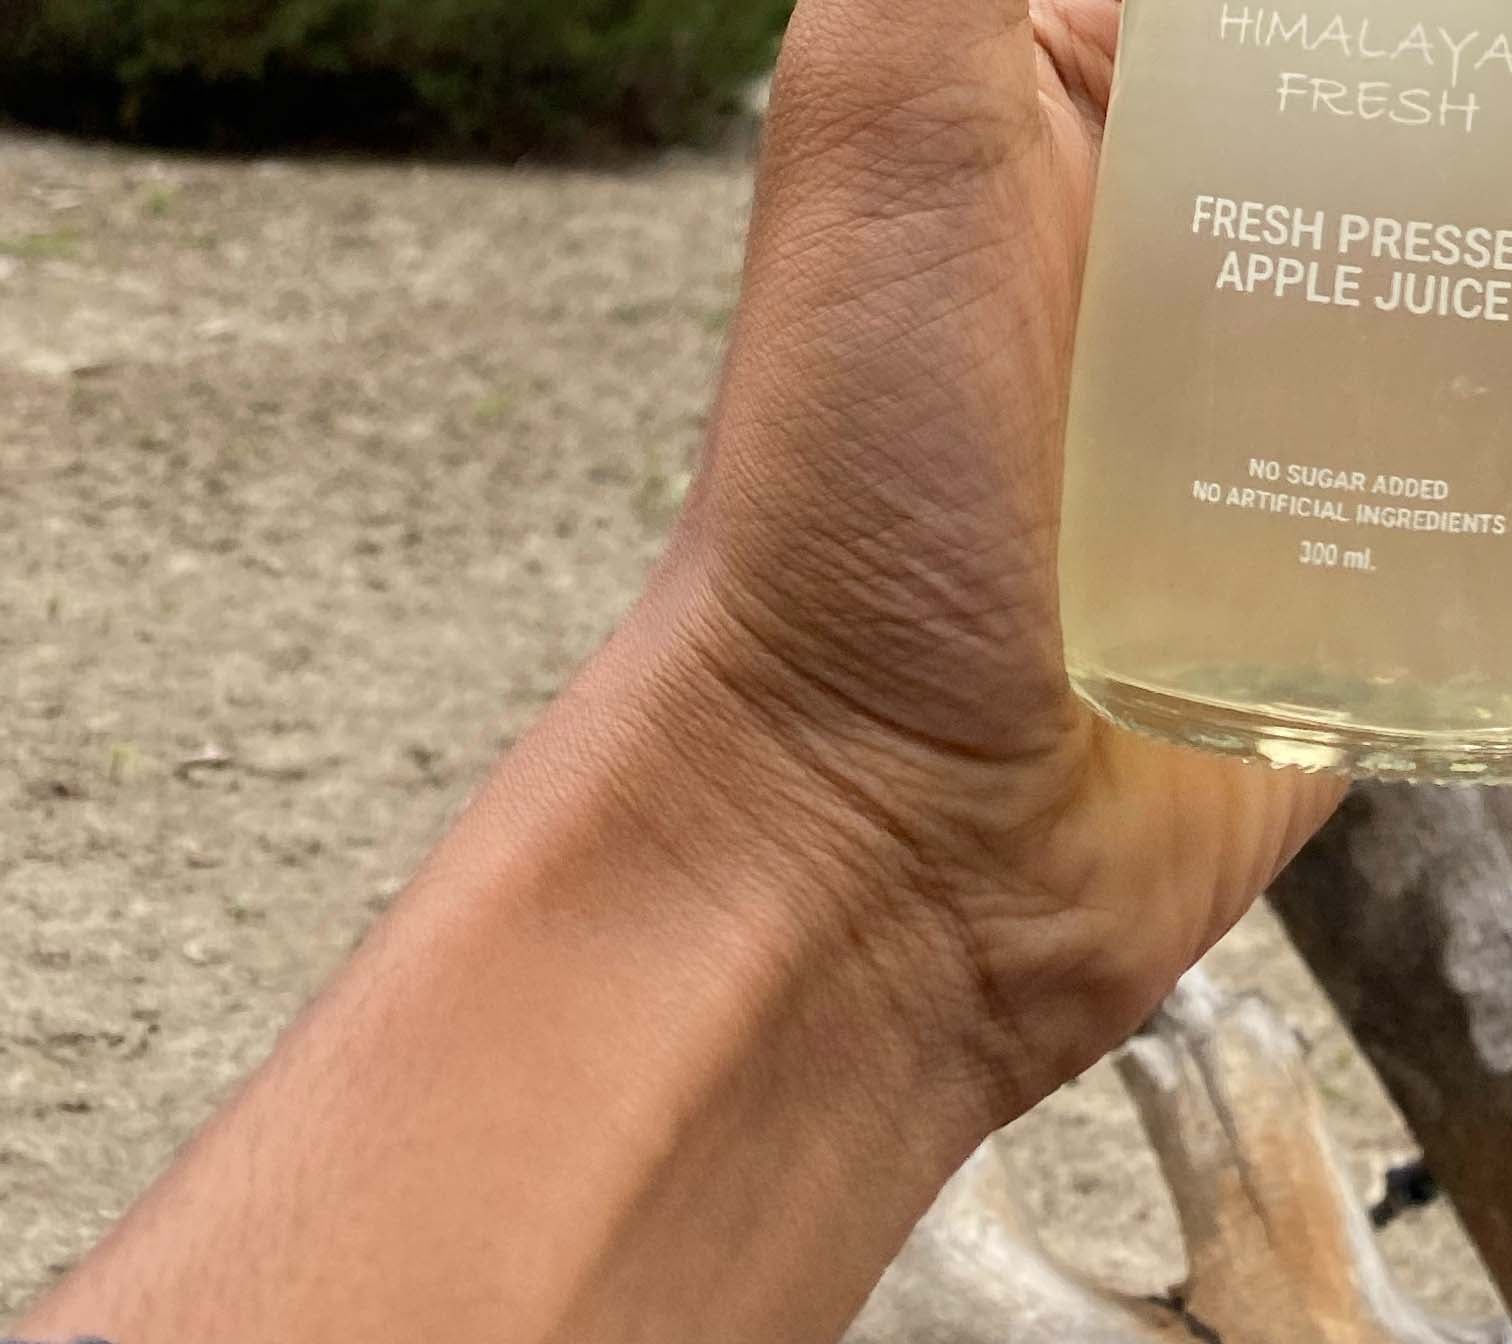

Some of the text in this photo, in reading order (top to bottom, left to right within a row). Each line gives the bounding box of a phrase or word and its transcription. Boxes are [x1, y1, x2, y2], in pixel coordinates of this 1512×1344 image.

[1276, 72, 1480, 132] FRESH
[1191, 194, 1325, 251] FRESH
[1215, 250, 1512, 321] APPLE JUICE
[1248, 458, 1449, 500] NO SUGAR ADDED
[1192, 480, 1506, 535] NO ARTIFICIAL INGREDIENTS
[1299, 540, 1338, 566] 300
